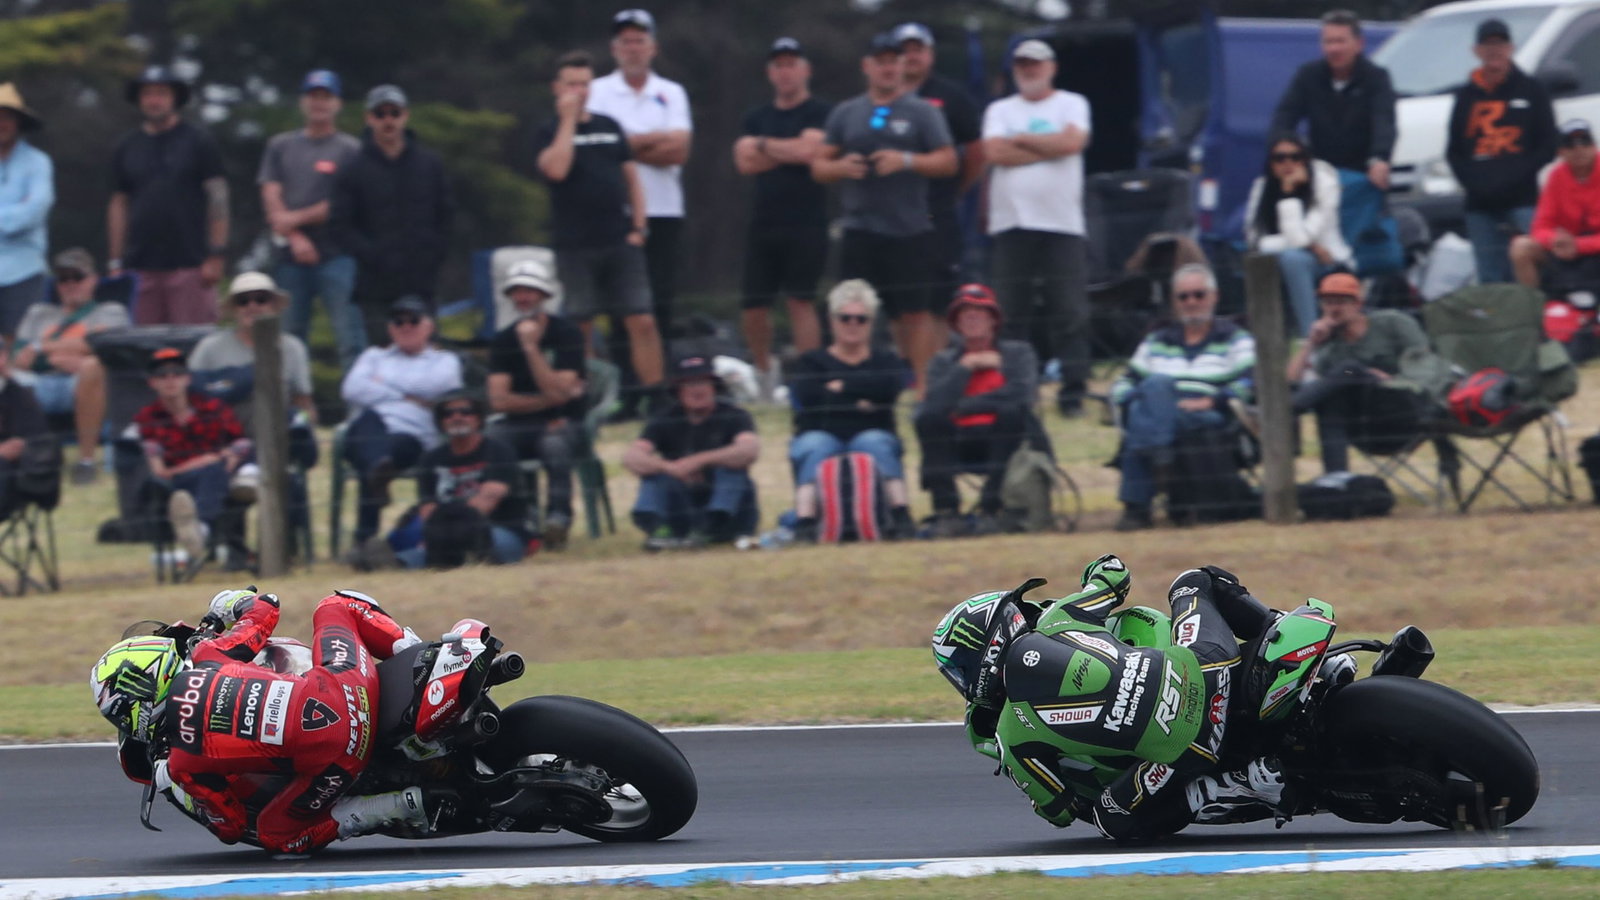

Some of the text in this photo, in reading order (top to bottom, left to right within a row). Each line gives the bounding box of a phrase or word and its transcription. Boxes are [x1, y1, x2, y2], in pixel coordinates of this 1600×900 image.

[984, 629, 1005, 665] KYT
[1296, 645, 1317, 658] MOTUL
[1071, 657, 1092, 691] Ninja
[1103, 651, 1142, 732] Kawasaki
[1123, 657, 1151, 726] Racing Team
[240, 682, 262, 736] Lenovo
[266, 698, 282, 724] riello
[430, 698, 456, 720] motorola
[1154, 659, 1183, 735] RST
[1049, 709, 1092, 723] SHOWA
